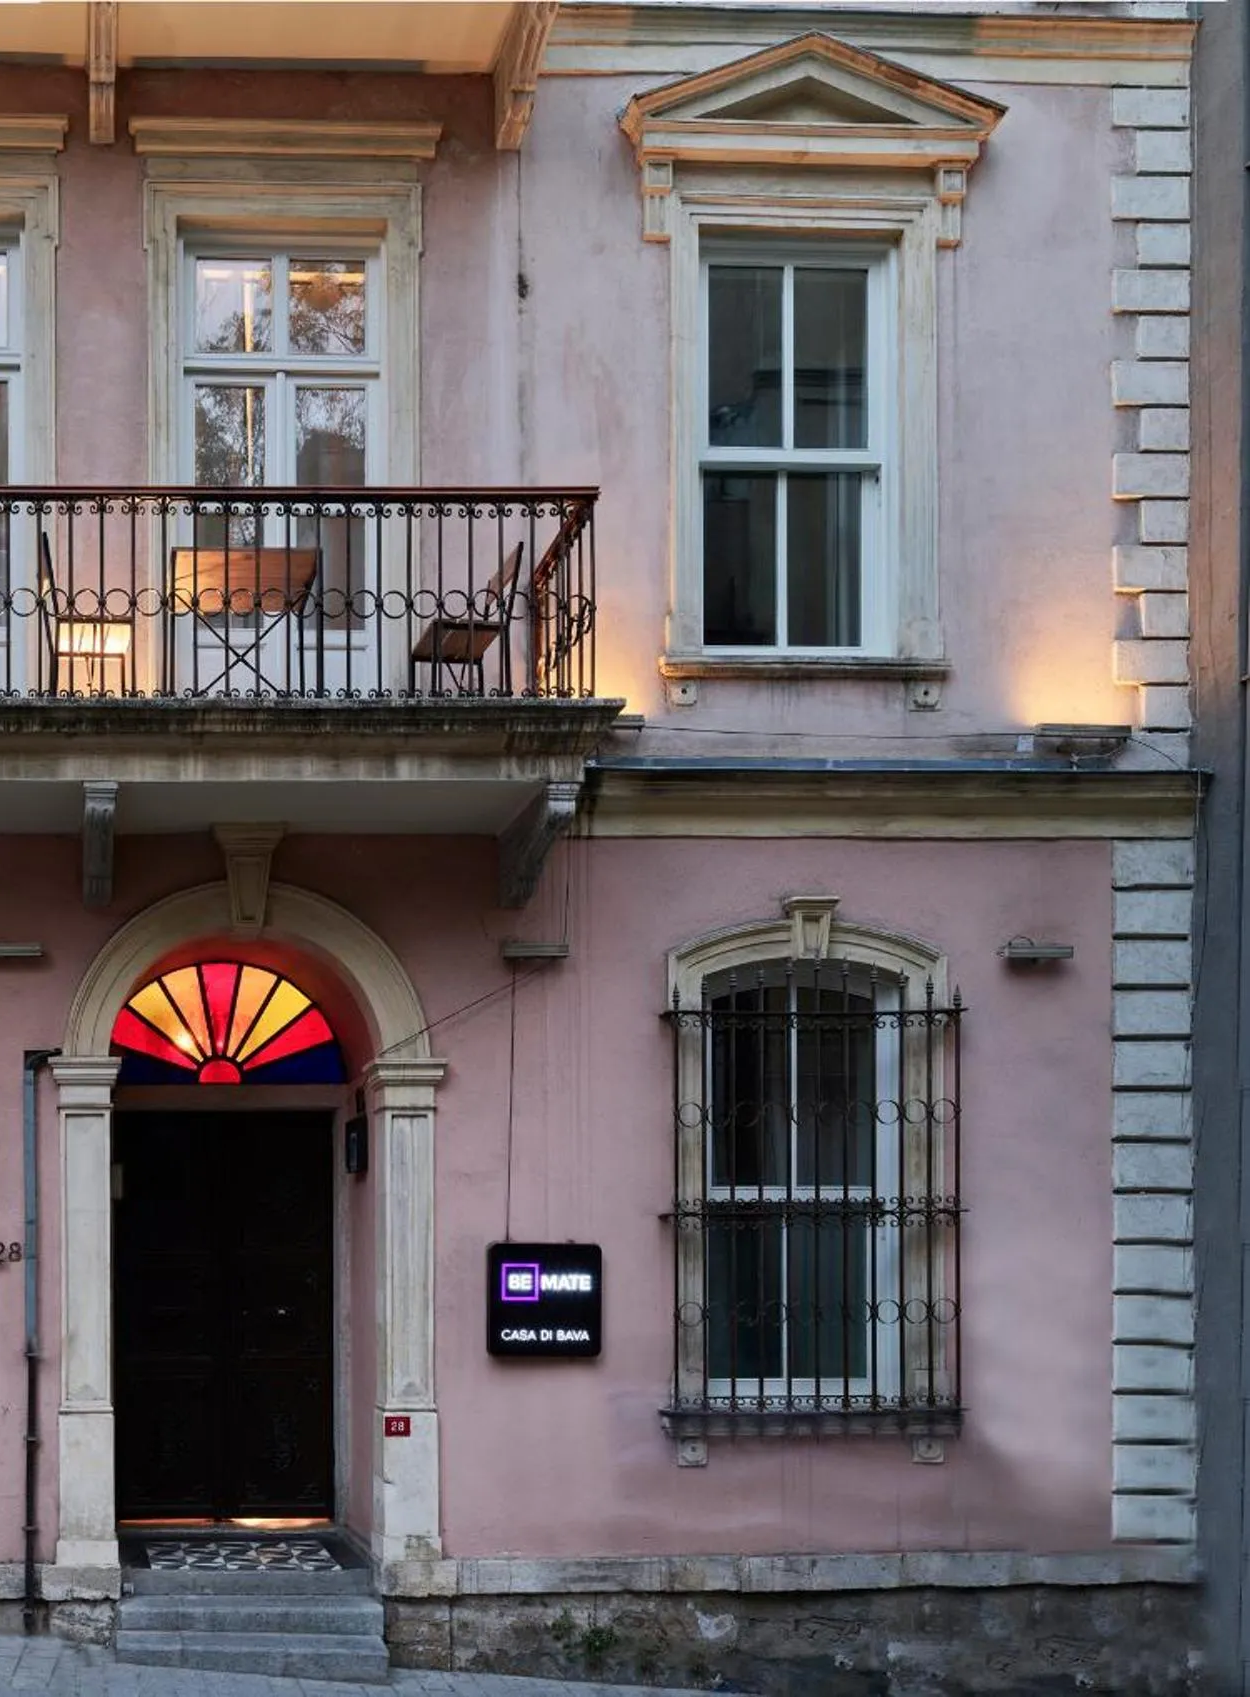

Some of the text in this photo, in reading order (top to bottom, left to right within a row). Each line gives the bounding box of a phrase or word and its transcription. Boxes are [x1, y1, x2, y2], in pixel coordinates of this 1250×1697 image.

[508, 1273, 592, 1291] BE MATE
[501, 1329, 590, 1341] CASA DI BAVA
[391, 1421, 405, 1432] 28
